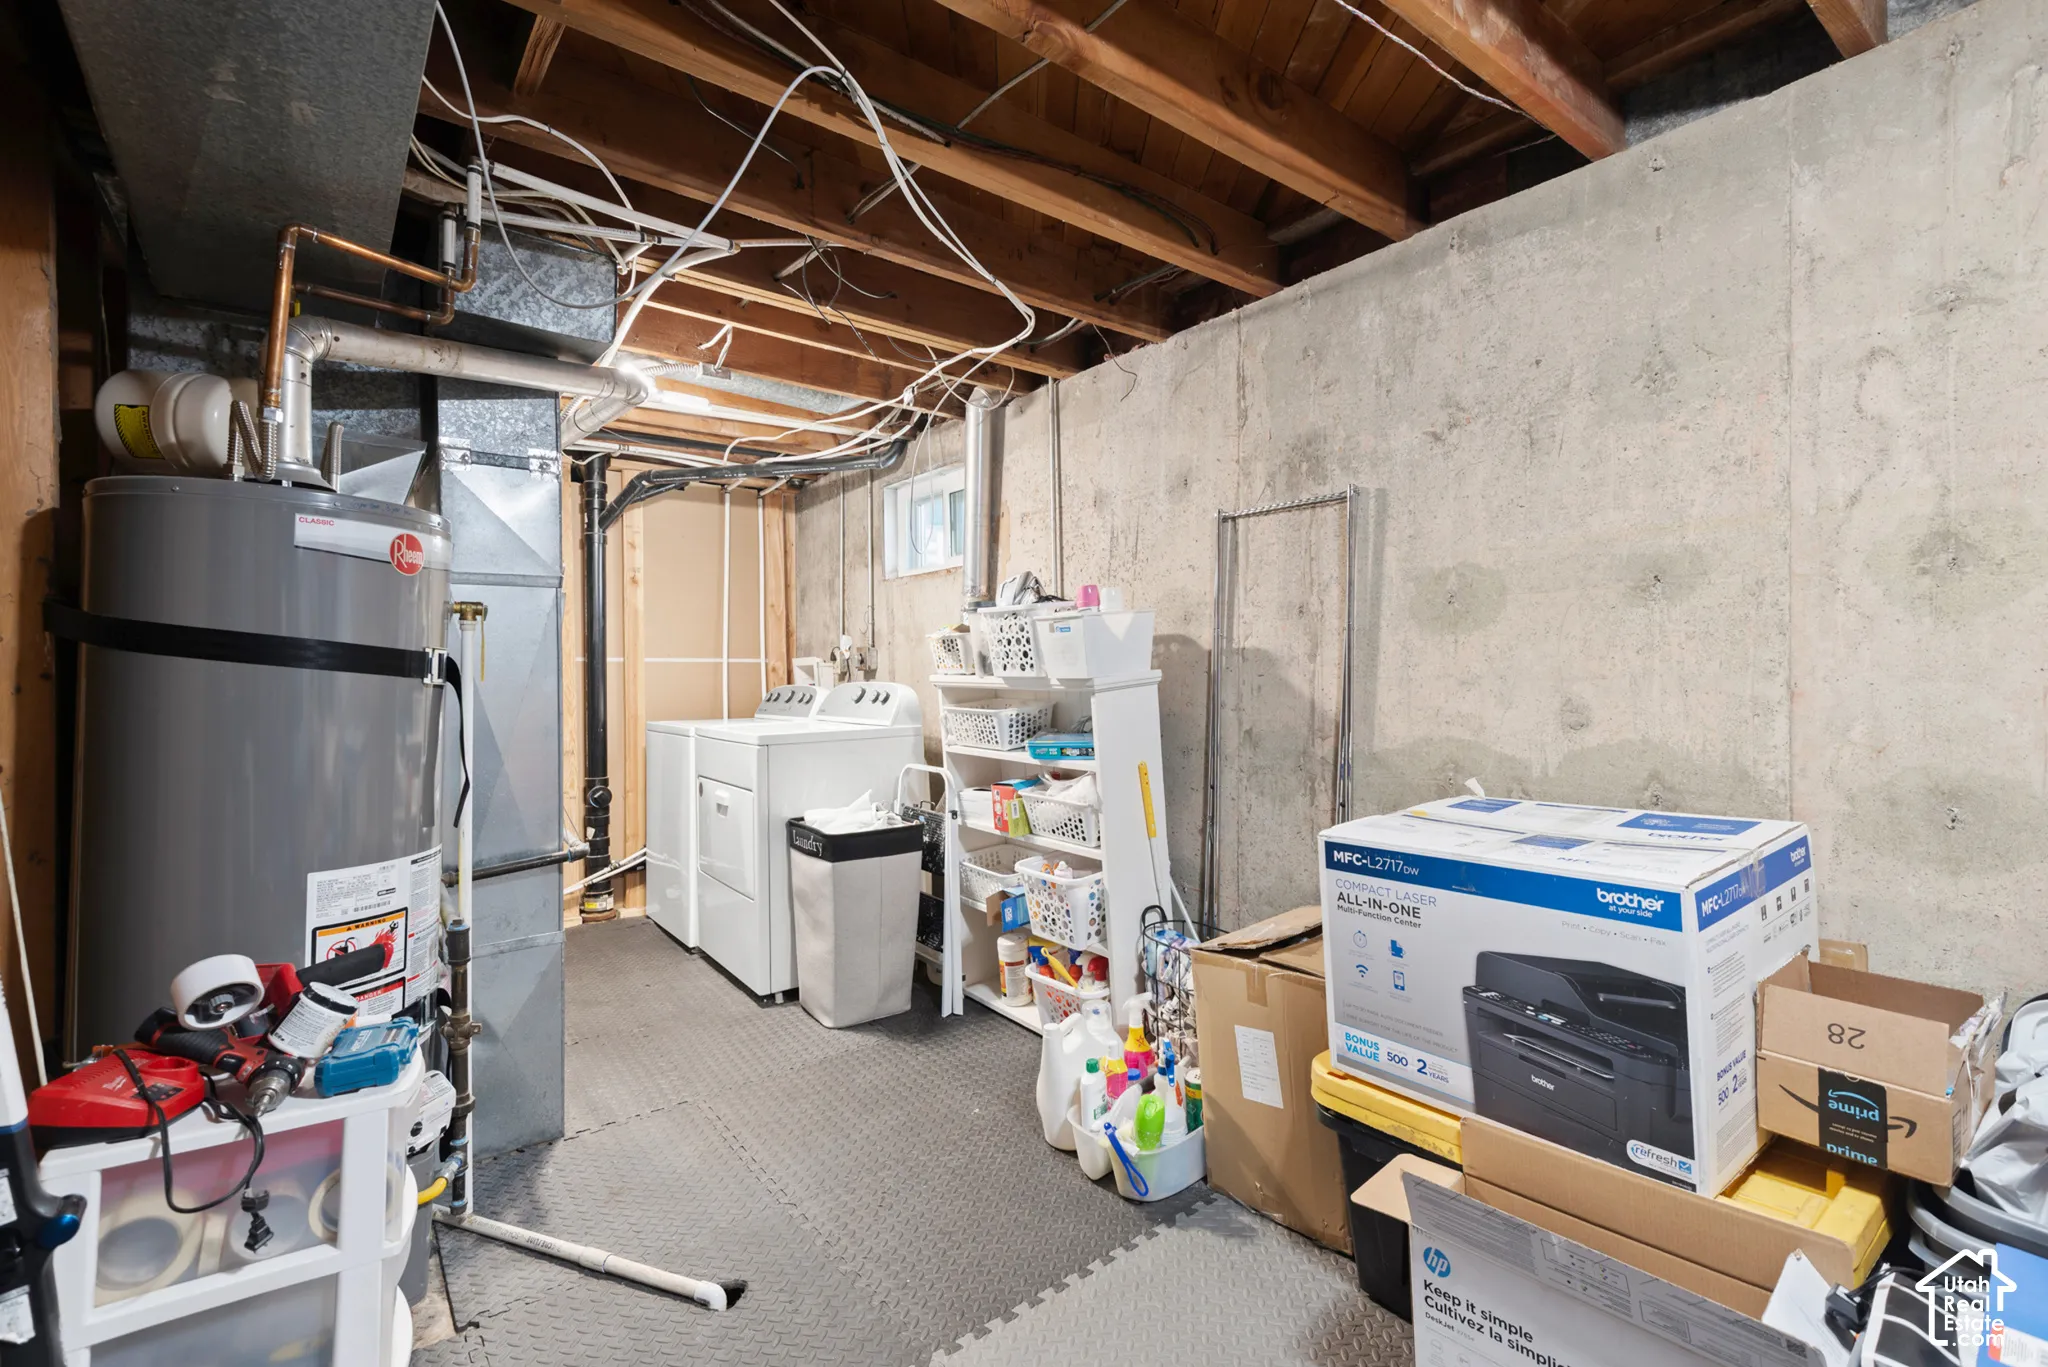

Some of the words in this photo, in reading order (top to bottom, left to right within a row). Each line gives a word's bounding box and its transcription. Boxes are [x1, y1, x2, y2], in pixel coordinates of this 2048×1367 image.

[299, 516, 334, 527] CLASSIC
[394, 534, 423, 568] Rheem
[1333, 850, 1420, 876] MFC-L2717DW
[1335, 878, 1392, 899] COMPACT
[1395, 890, 1437, 907] LASER
[1596, 888, 1664, 912] brother
[1336, 891, 1421, 919] ALL-IN-ONE
[1618, 907, 1635, 916] your
[1637, 909, 1653, 918] side
[355, 918, 387, 930] WARNING
[1337, 904, 1392, 923] Multi-Function
[1394, 917, 1422, 929] Center
[1561, 920, 1580, 931] Print
[1588, 925, 1611, 937] Copy
[1620, 931, 1641, 941] Scan
[1650, 936, 1666, 946] Fax
[1344, 1032, 1380, 1051] BONUS
[1827, 1023, 1866, 1050] 28
[1345, 1042, 1380, 1063] VALUE
[1387, 1051, 1409, 1067] 500
[1416, 1058, 1428, 1075] 2
[1716, 1062, 1732, 1082] BONUS
[1732, 1050, 1746, 1067] VALUE
[1428, 1072, 1450, 1084] YEARS
[1531, 1074, 1555, 1091] brother
[1732, 1074, 1738, 1094] 2
[1718, 1086, 1729, 1106] 500
[1828, 1099, 1880, 1122] prime
[1635, 1146, 1677, 1168] refresh
[1427, 1247, 1448, 1277] hp
[1424, 1279, 1461, 1307] Keep
[1466, 1299, 1477, 1315] it
[1480, 1307, 1534, 1343] simple
[1425, 1295, 1485, 1335] Cultivez
[1489, 1326, 1503, 1344] la
[1425, 1311, 1455, 1333] DeskJet
